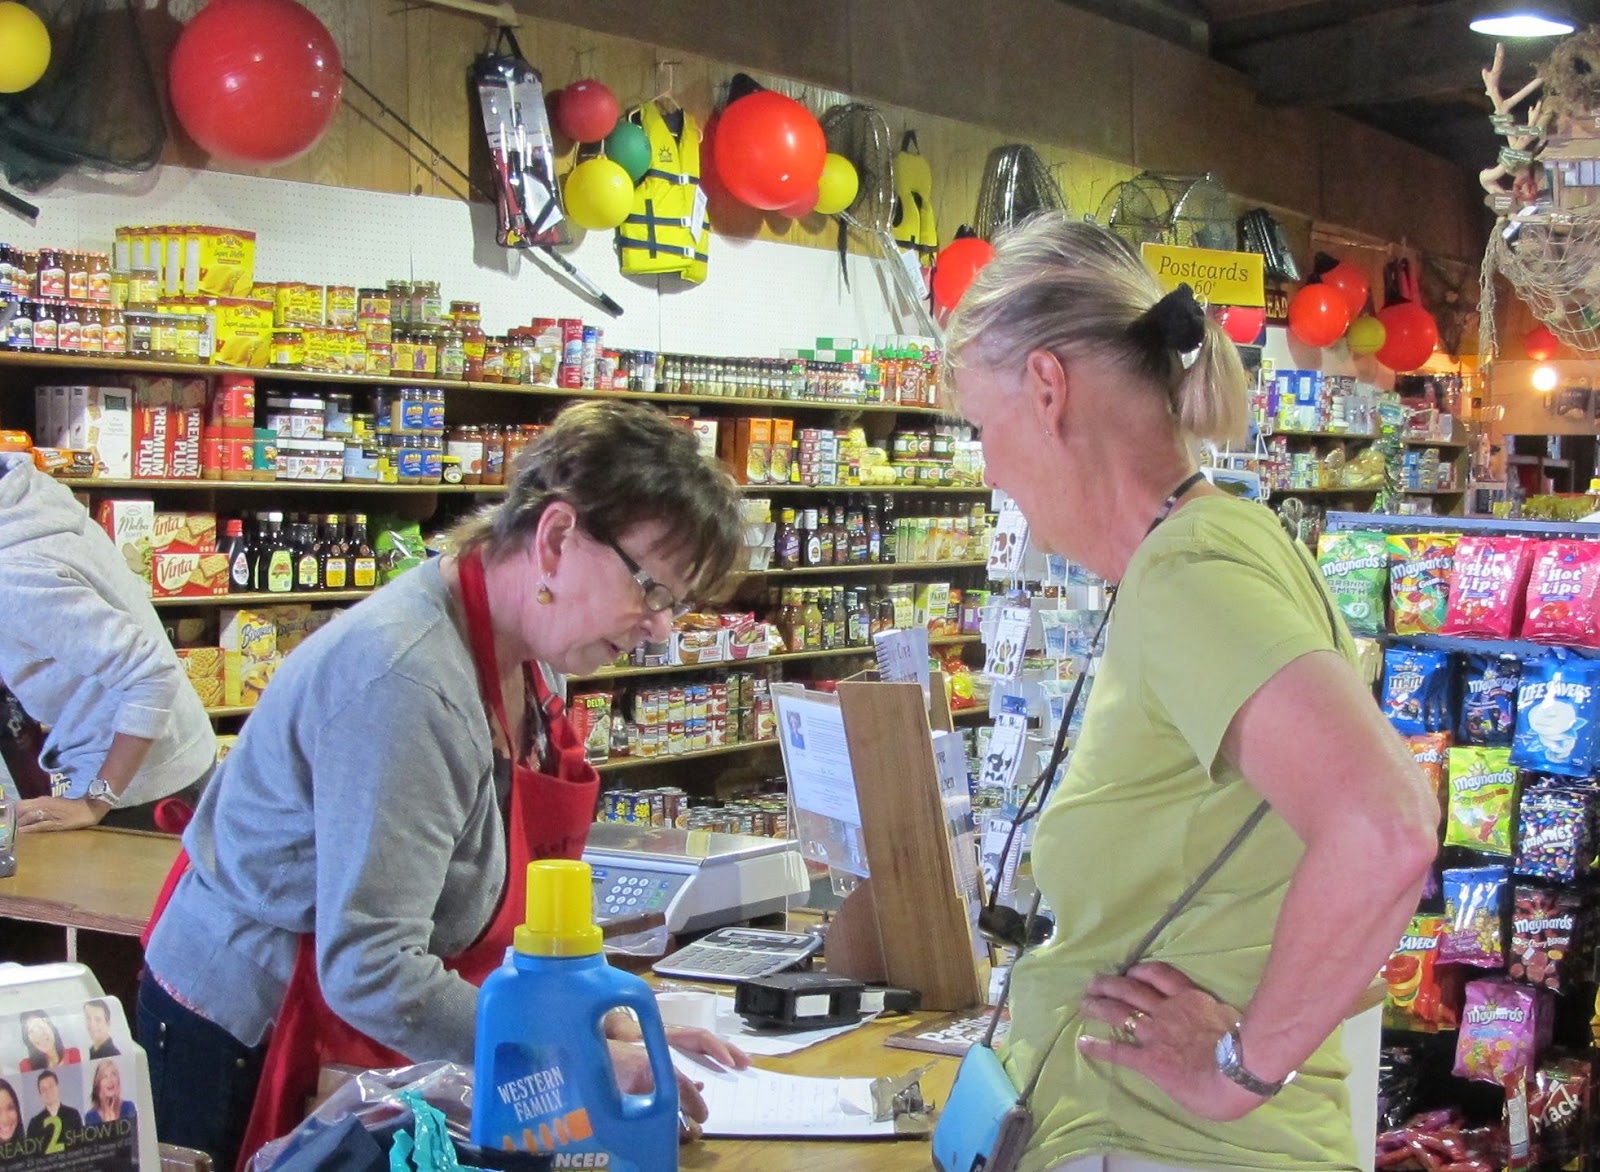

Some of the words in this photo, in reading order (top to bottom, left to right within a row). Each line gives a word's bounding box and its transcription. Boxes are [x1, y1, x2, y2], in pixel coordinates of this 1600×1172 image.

[1159, 256, 1249, 282] Postcards
[1266, 296, 1288, 319] EAD
[151, 406, 167, 476] PREMIUM
[185, 407, 201, 477] PREMIUM
[139, 439, 154, 476] PLUS
[173, 440, 188, 478] PLUS
[117, 516, 149, 535] Melba
[160, 556, 193, 584] Vinta
[1546, 569, 1583, 581] Hot
[1458, 577, 1501, 592] Lips
[1540, 582, 1582, 596] Lips
[586, 697, 606, 708] DELTA
[1453, 769, 1514, 792] Maynards
[1514, 914, 1573, 935] Maynards
[1395, 935, 1438, 954] SAVERS
[497, 1066, 564, 1104] WESTERN
[513, 1089, 563, 1122] FAMILY
[0, 1136, 45, 1159] READY
[43, 1116, 65, 1154] 2
[65, 1124, 112, 1146] SHOW
[115, 1119, 130, 1136] ID
[551, 1152, 610, 1168] NCED
